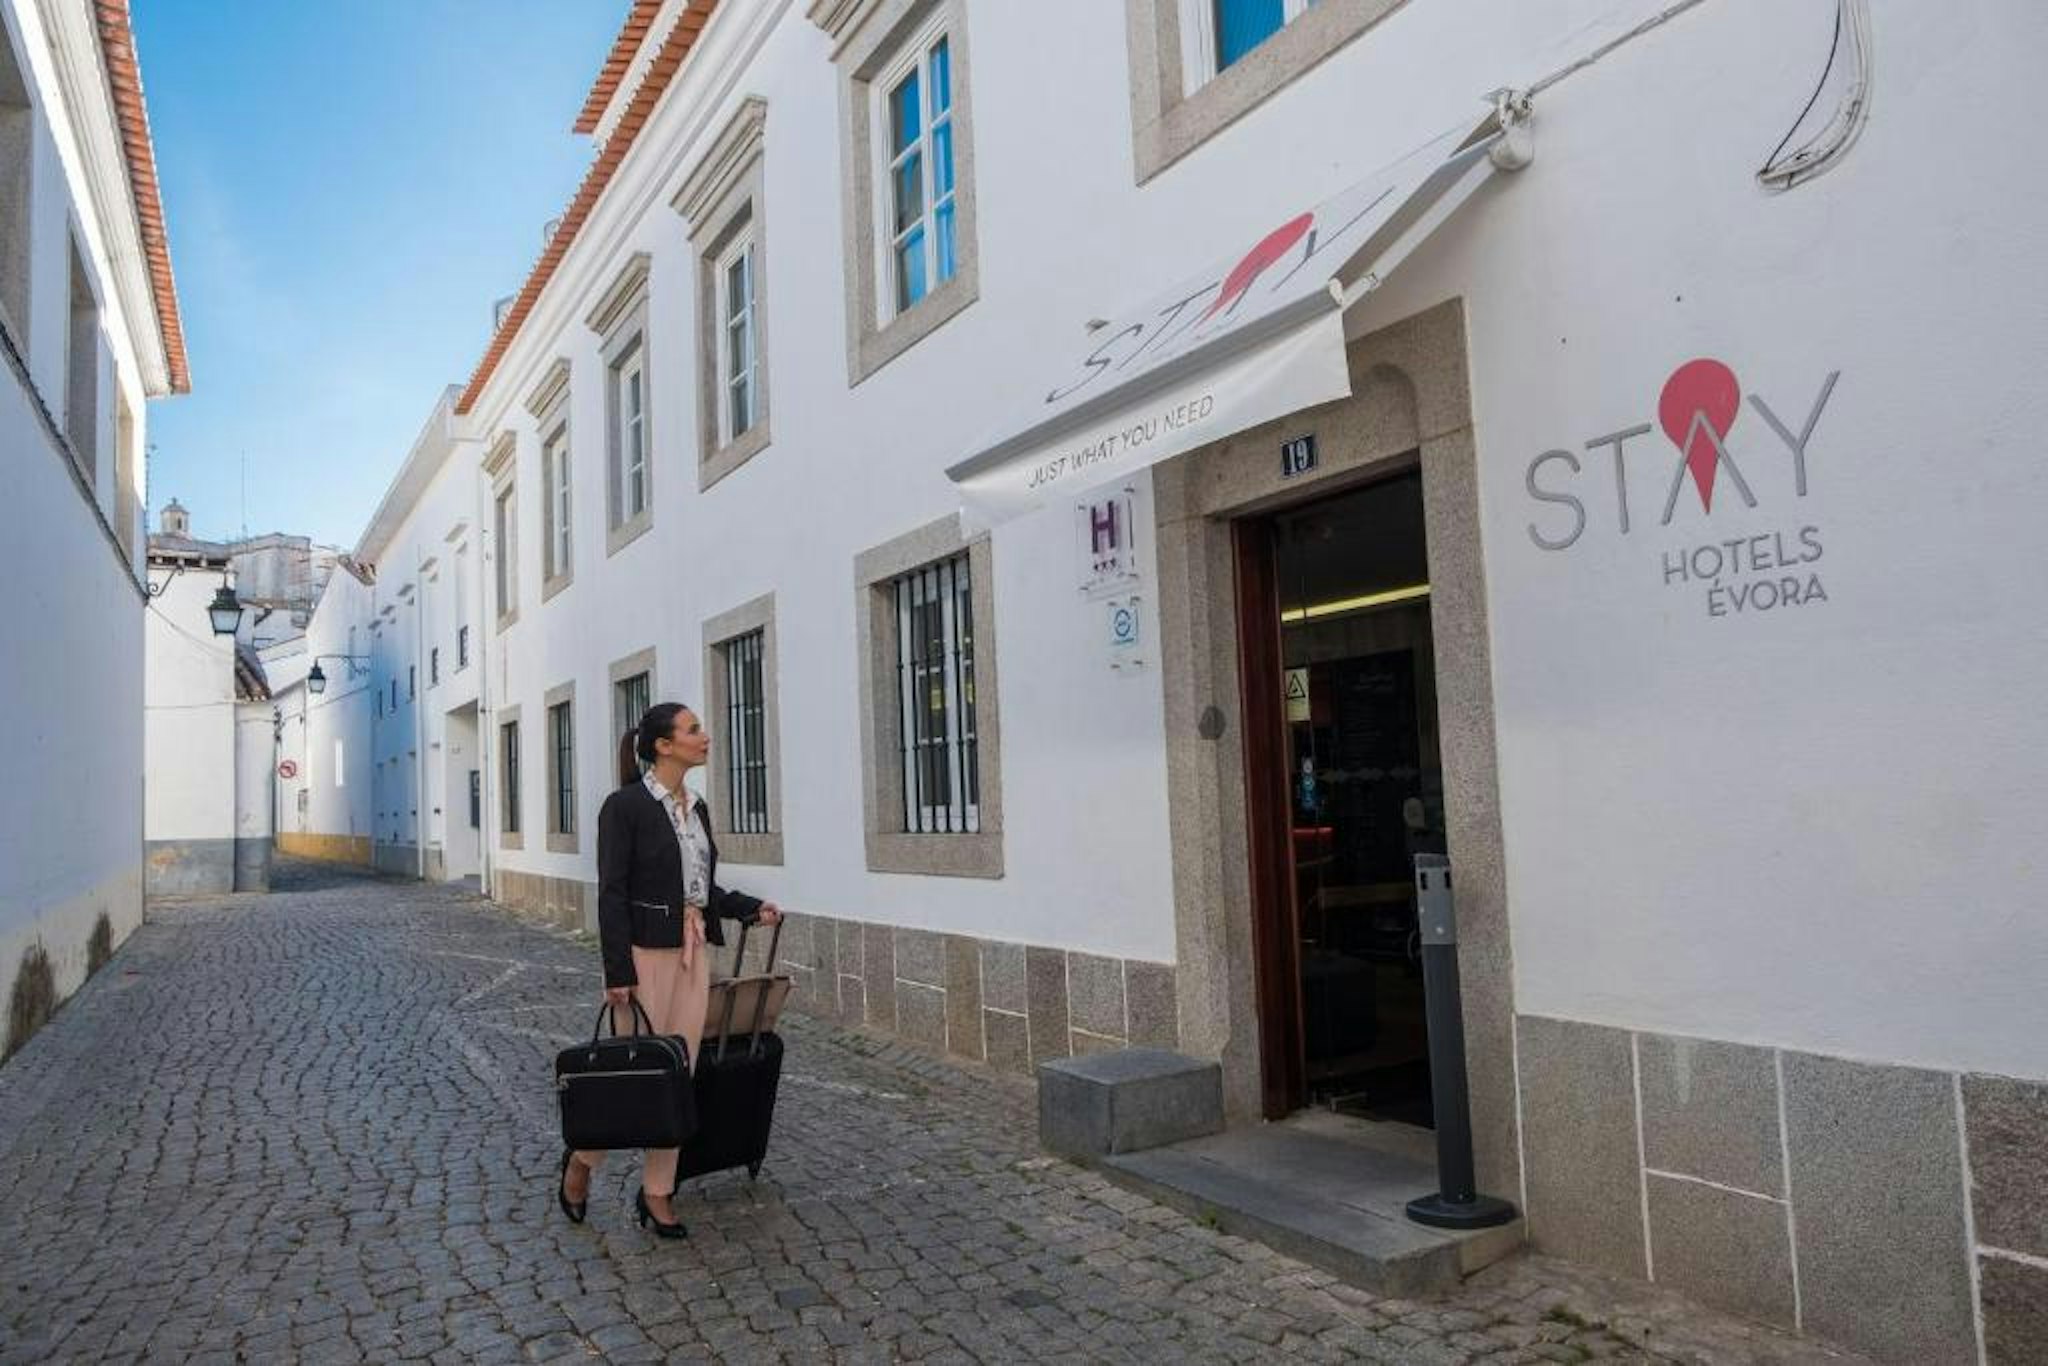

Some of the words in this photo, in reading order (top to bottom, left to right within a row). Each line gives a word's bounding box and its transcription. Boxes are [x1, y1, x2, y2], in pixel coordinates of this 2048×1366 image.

[1029, 460, 1067, 488] JUST
[1072, 437, 1117, 472] WHAT
[1121, 420, 1157, 453] YOU
[1163, 394, 1214, 432] NEED
[1287, 440, 1311, 475] 19
[1525, 370, 1841, 551] STAY
[1090, 500, 1117, 554] H
[1662, 526, 1823, 585] HOTELS
[1707, 574, 1828, 617] ÉVORA
